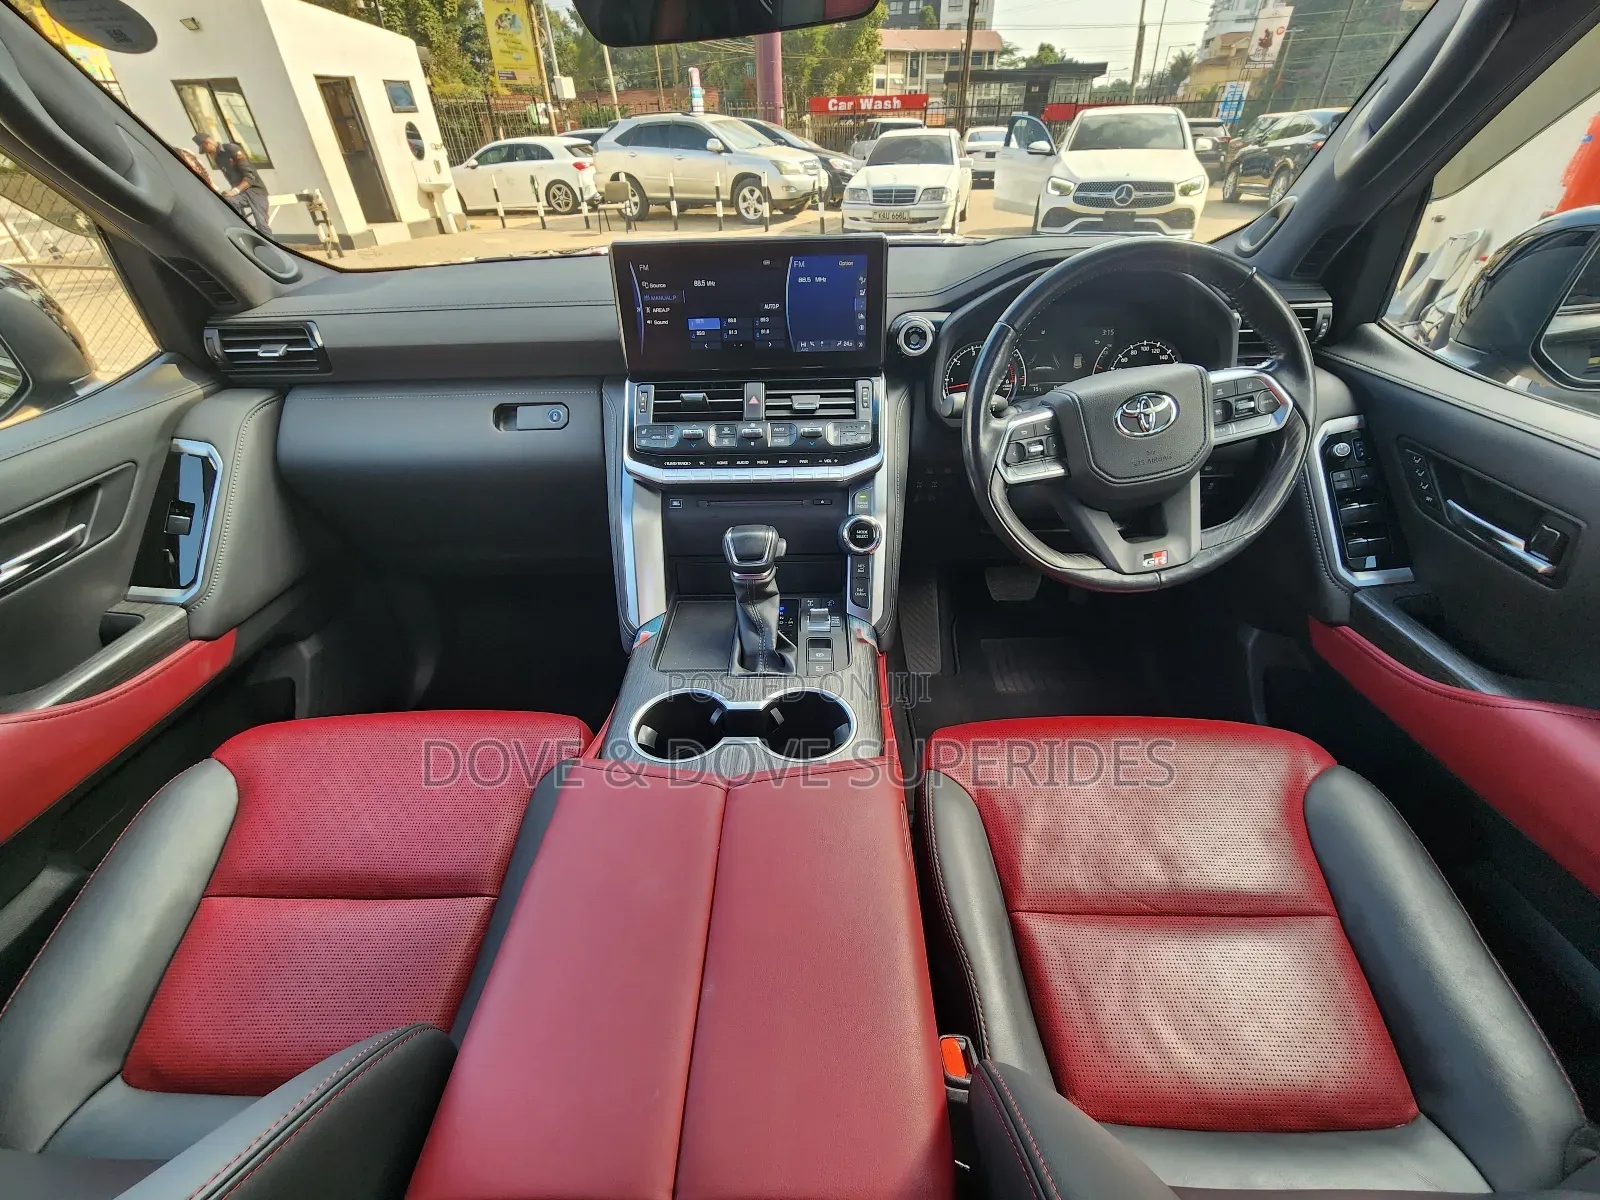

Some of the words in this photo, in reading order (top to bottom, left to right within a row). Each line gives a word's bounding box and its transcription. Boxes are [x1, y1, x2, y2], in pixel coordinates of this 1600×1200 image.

[828, 98, 854, 111] Car
[860, 97, 902, 110] Wash
[639, 264, 650, 272] FM
[793, 260, 805, 268] FM
